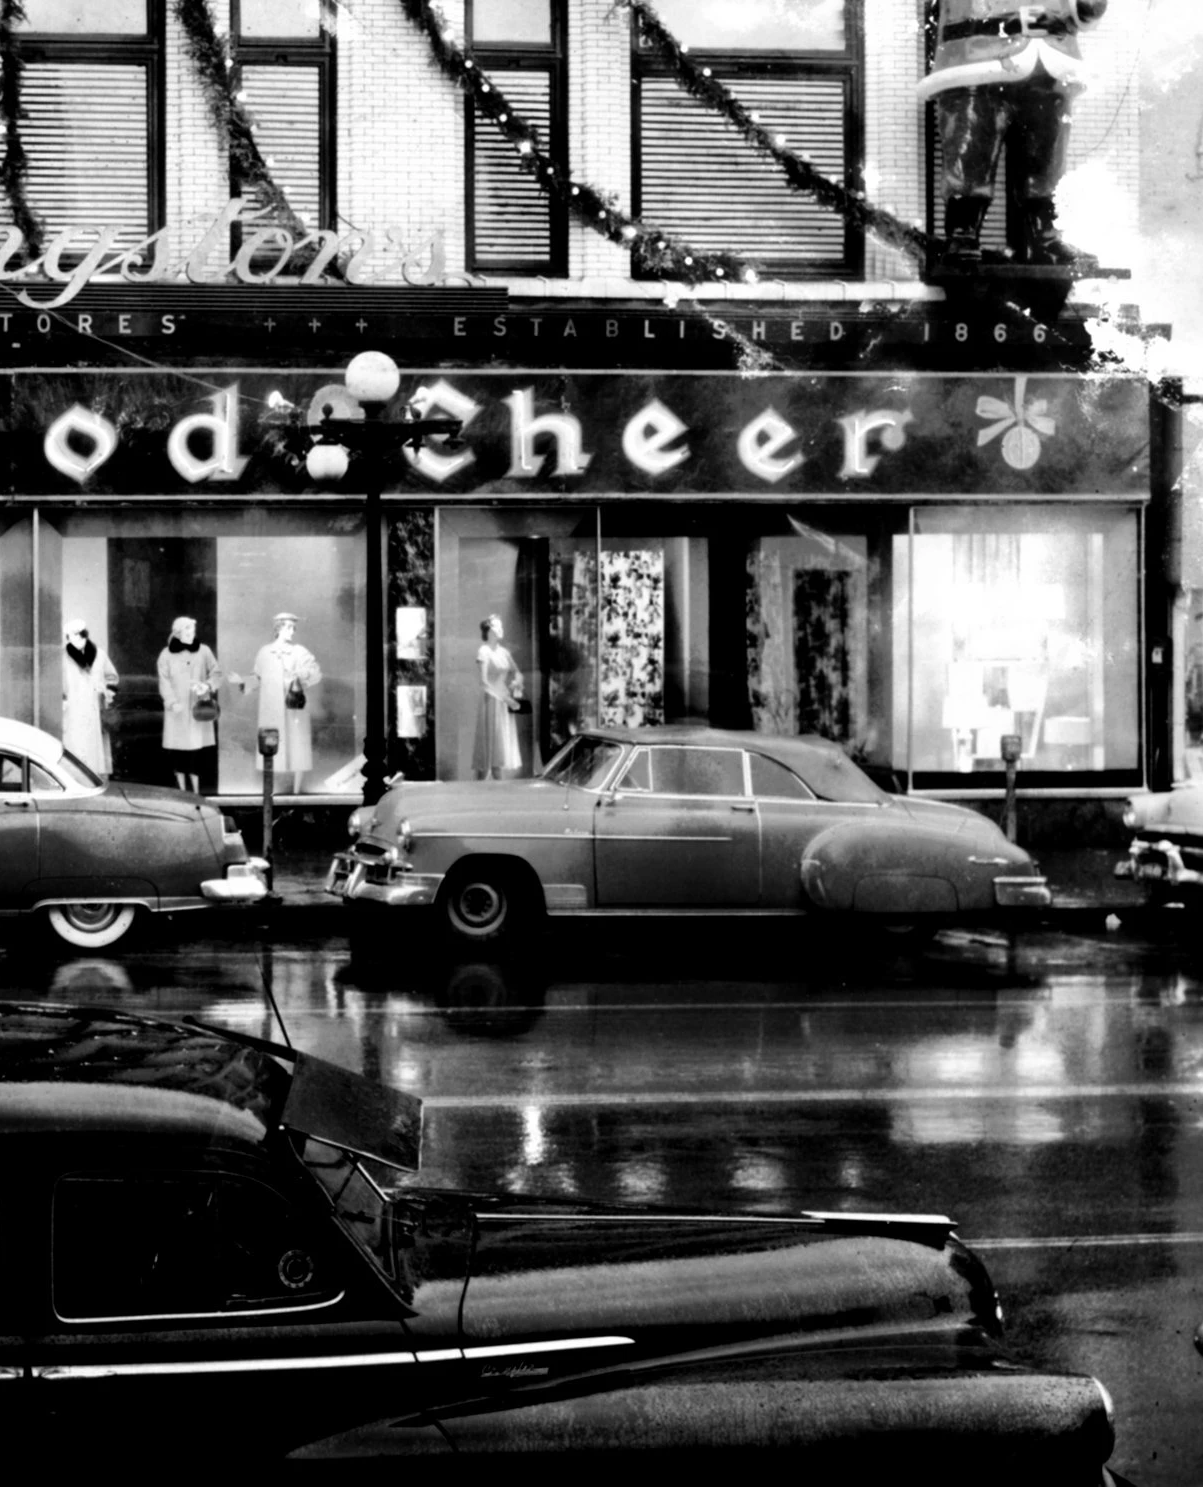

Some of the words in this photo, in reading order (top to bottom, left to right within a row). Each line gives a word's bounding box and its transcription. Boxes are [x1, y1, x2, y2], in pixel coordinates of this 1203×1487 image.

[454, 316, 845, 341] ESTABLISHED
[925, 323, 1047, 342] 1866
[402, 377, 912, 484] Cheer
